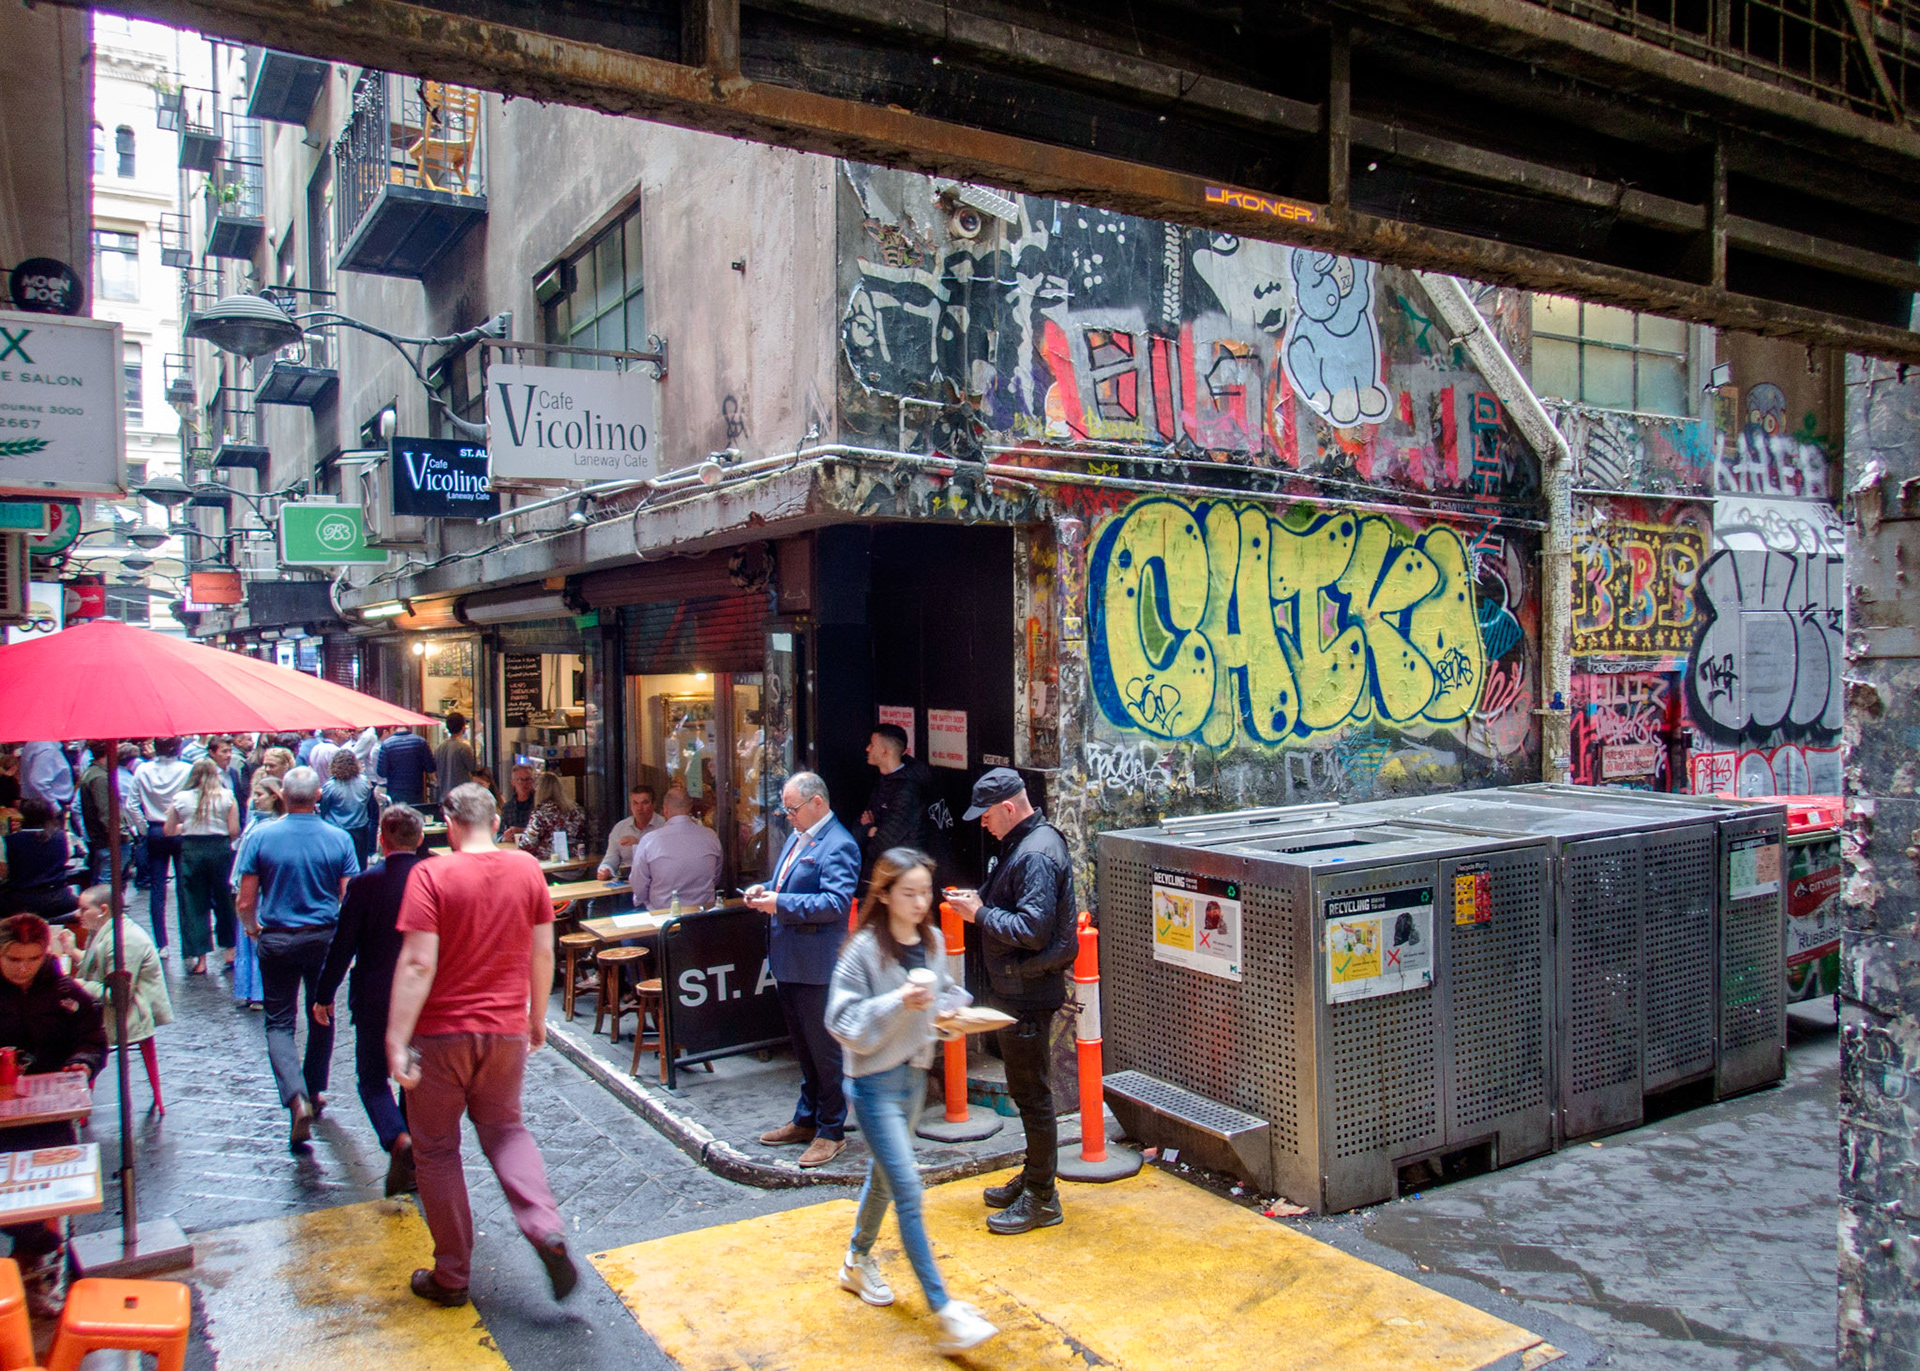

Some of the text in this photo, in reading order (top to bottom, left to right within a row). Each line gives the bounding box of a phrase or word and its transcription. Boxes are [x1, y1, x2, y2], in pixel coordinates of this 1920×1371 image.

[25, 287, 63, 302] DOG
[0, 326, 36, 364] X
[20, 372, 83, 387] SALON
[539, 390, 574, 409] Cafe
[0, 403, 84, 416] OURNE 3000
[495, 382, 648, 451] Vicolino
[459, 448, 474, 458] ST.
[574, 453, 648, 469] Laneway Cafe
[403, 451, 490, 492] Vicolino
[428, 458, 448, 469] Cafe
[447, 492, 490, 501] Laneway Cafe
[1153, 871, 1186, 888] RECYCLING
[1809, 875, 1841, 892] CITYWID
[1329, 898, 1370, 916] RECYCLING
[1799, 925, 1840, 949] RUBBISH
[679, 958, 778, 1007] ST. A
